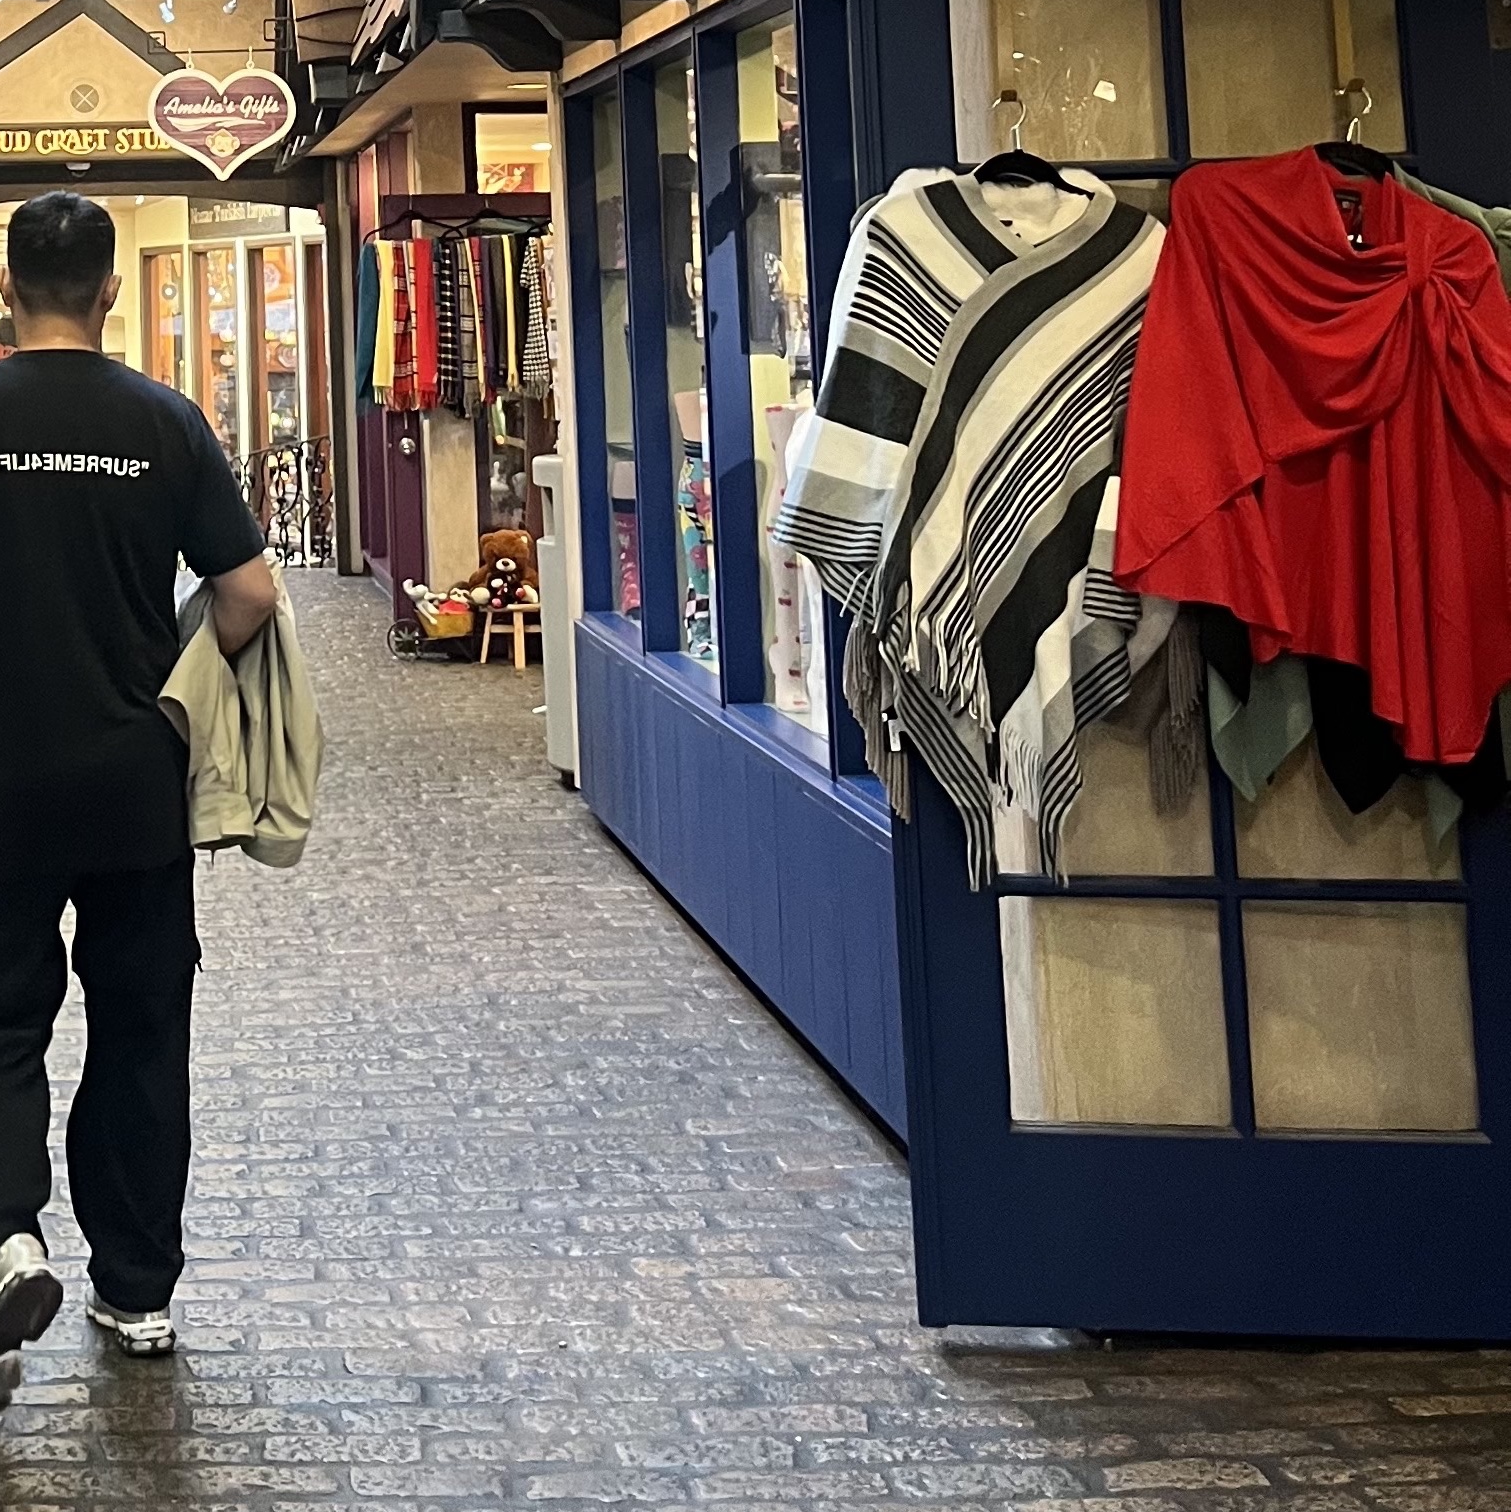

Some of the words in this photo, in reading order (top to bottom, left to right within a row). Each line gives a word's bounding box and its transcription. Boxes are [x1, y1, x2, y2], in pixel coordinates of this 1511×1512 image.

[163, 95, 236, 115] Amelia's
[239, 94, 280, 120] Gifts
[35, 128, 110, 155] CRAFT
